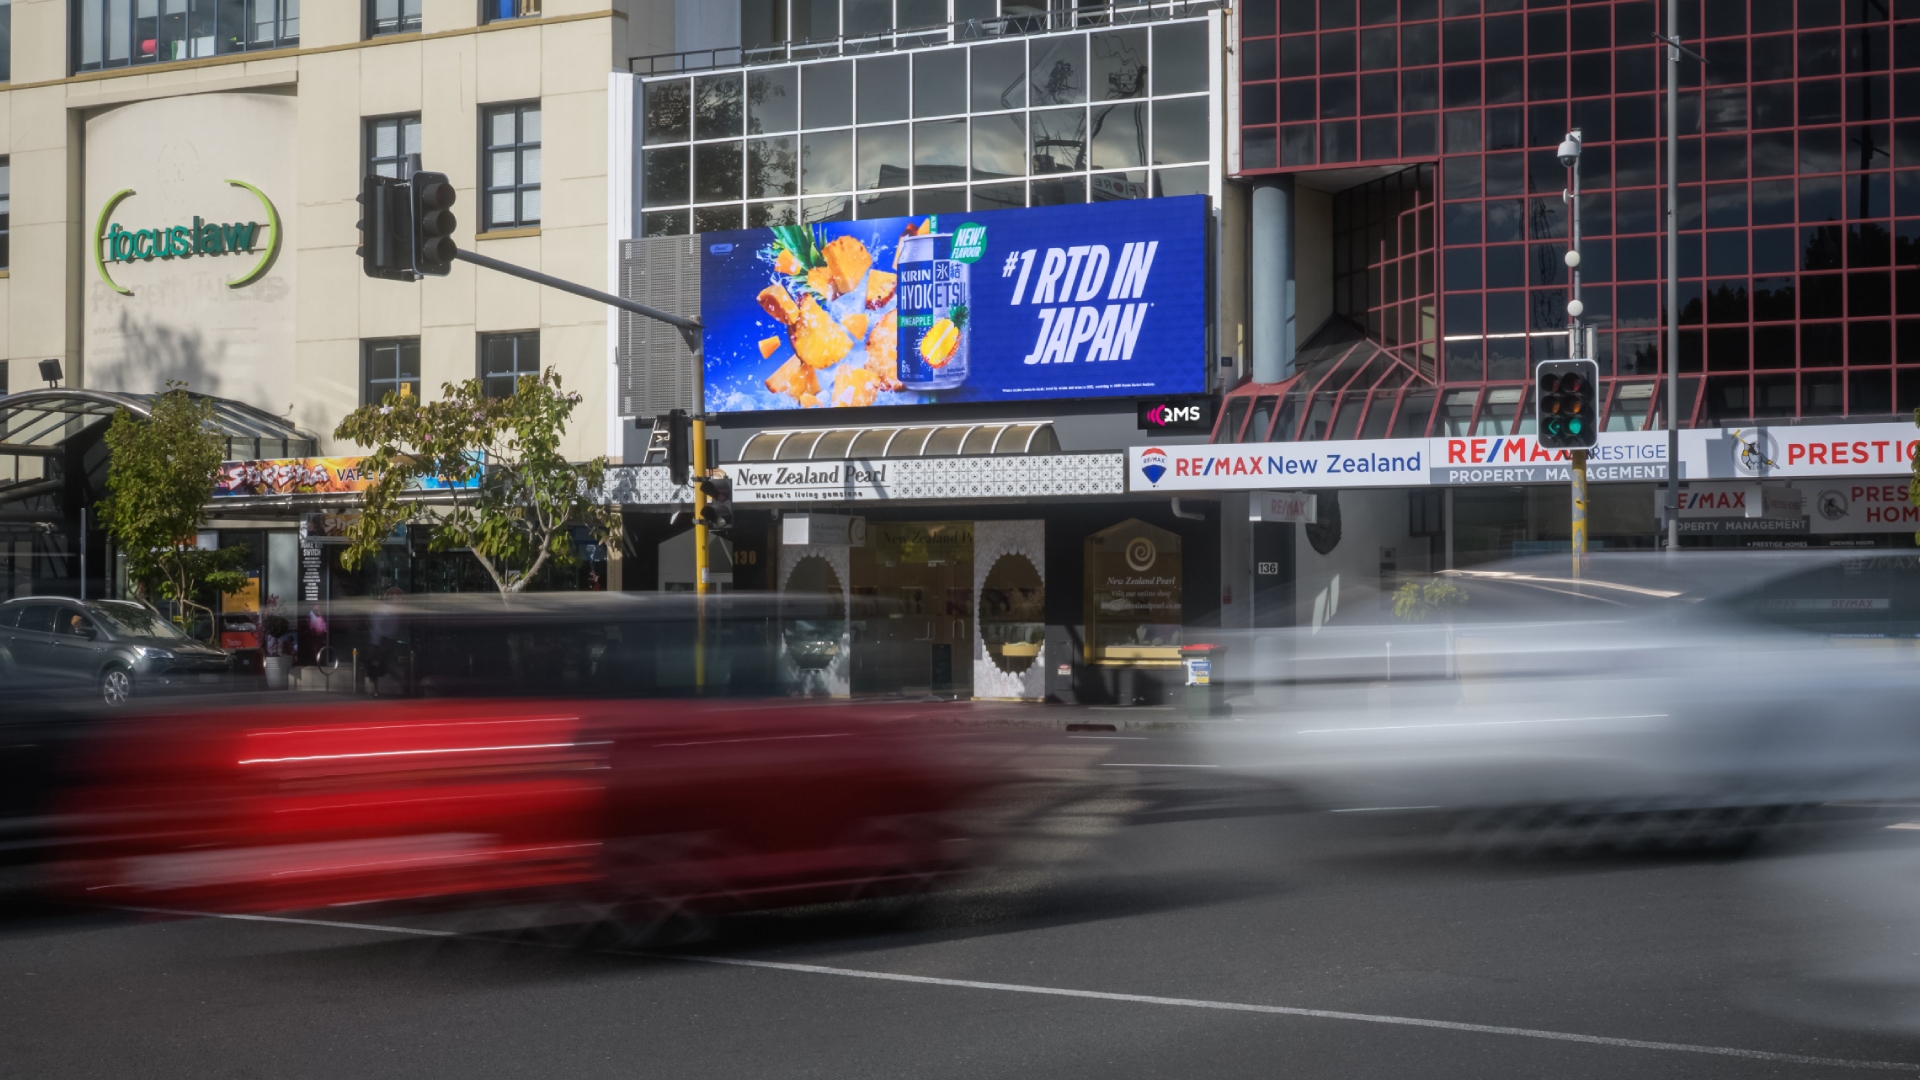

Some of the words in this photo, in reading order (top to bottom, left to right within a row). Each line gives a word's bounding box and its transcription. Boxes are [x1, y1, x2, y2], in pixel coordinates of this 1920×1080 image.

[954, 226, 987, 247] NEW!
[951, 246, 982, 259] FLAVOUR
[901, 269, 931, 282] KIRIN
[1002, 249, 1037, 306] #1
[1031, 245, 1111, 305] RTD
[1107, 241, 1159, 300] IN
[901, 281, 966, 310] HYOKETSU
[901, 316, 931, 326] PINEAPPLE
[1156, 404, 1201, 425] QMS
[1590, 444, 1667, 461] RESTIGE
[1175, 456, 1263, 477] RE/MAX
[1268, 456, 1318, 475] New
[1326, 451, 1421, 474] Zealand
[336, 467, 374, 482] VAPE
[737, 468, 773, 486] New
[775, 465, 839, 485] Zealand
[844, 464, 887, 483] Pearl
[1450, 468, 1536, 482] PROPERTY
[1545, 465, 1667, 480] MAAGEMENT
[794, 490, 819, 499] living
[822, 490, 863, 499] gemstone
[1678, 491, 1745, 510] E/MAX
[1271, 498, 1306, 516] RE/MAX
[1726, 520, 1807, 532] MANAGEMENT
[884, 531, 908, 544] New
[911, 531, 958, 544] Zealand
[733, 551, 757, 565] 130
[1260, 563, 1276, 574] 136
[1107, 576, 1124, 585] New
[1125, 576, 1155, 585] Zealand
[1155, 576, 1176, 585] Pearl
[1157, 590, 1172, 599] shop
[1831, 600, 1873, 608] RE/MAX
